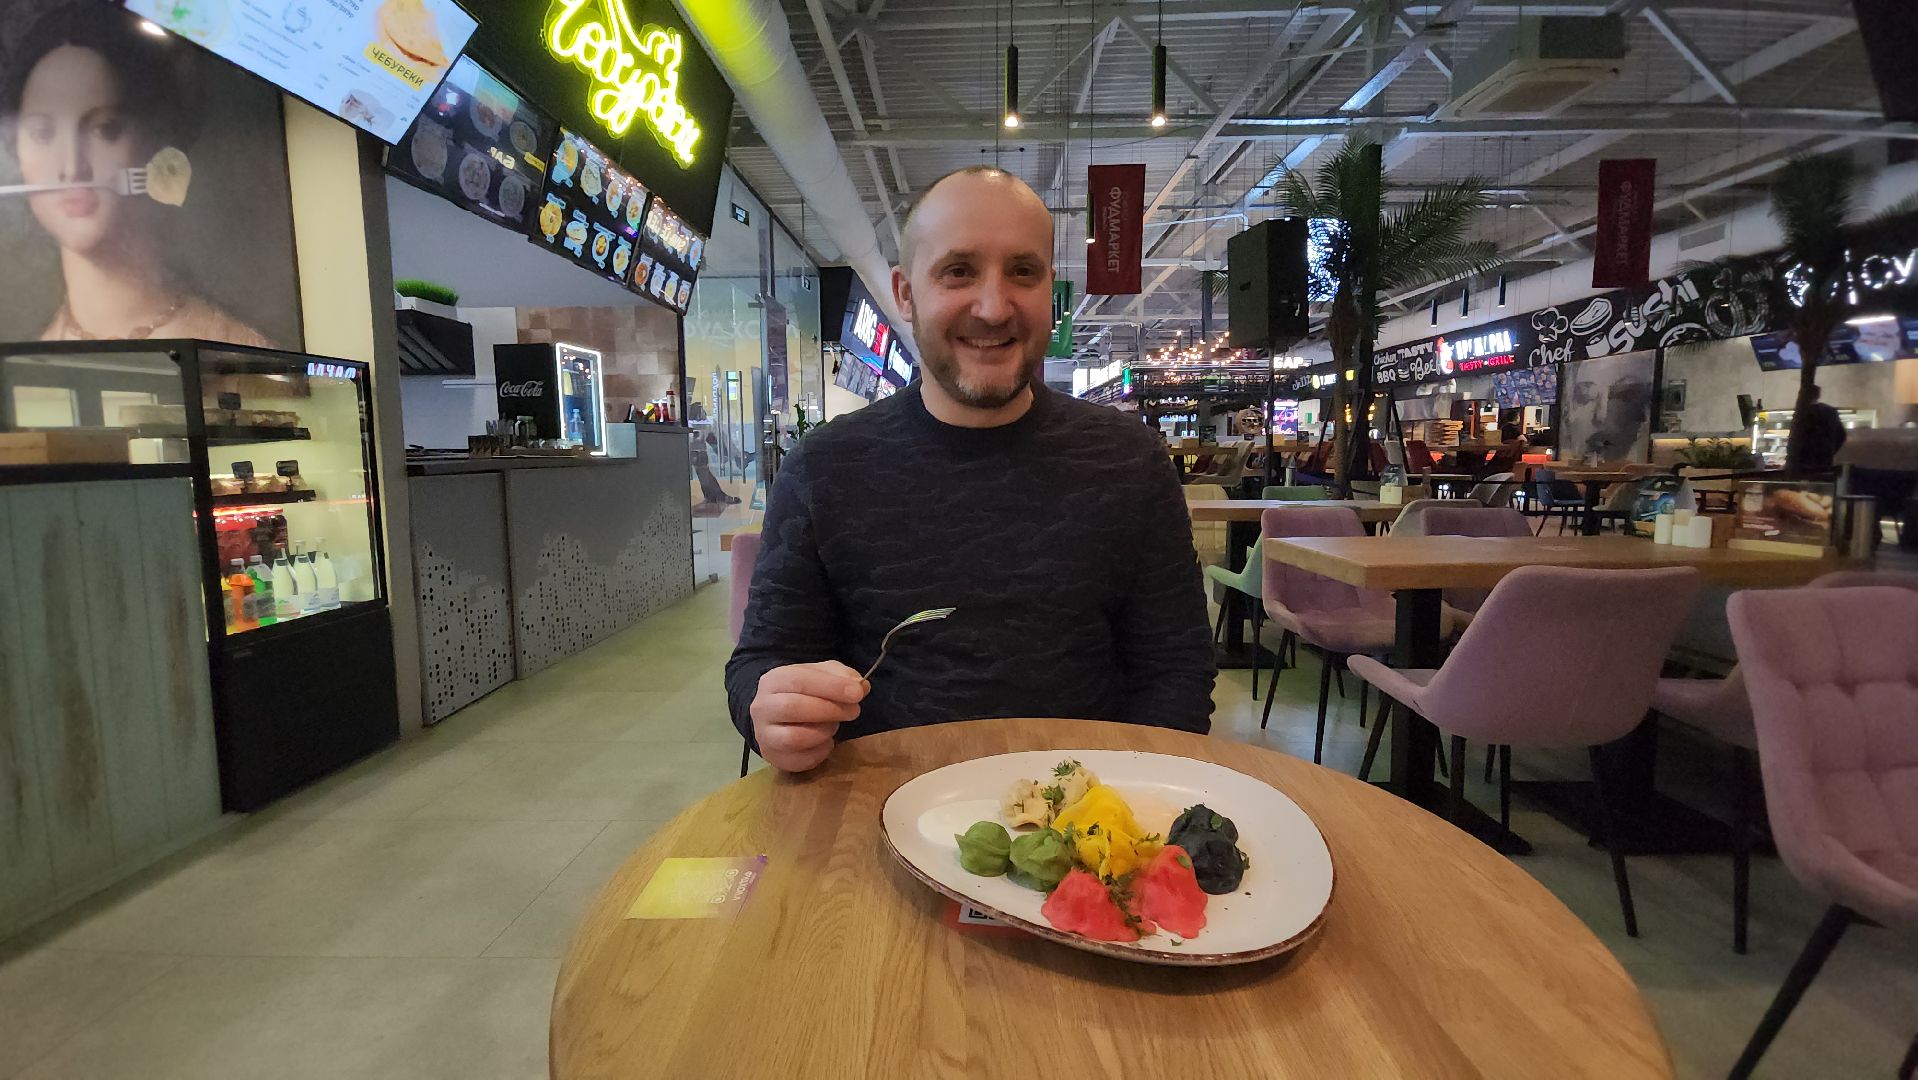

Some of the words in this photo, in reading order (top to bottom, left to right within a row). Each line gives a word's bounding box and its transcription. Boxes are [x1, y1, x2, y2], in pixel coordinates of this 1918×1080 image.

[372, 47, 424, 87] ЧЕБУРЕКИ
[1107, 186, 1122, 273] ФУДМАРКЕТ
[1397, 341, 1434, 358] TASTY
[1377, 368, 1396, 384] BBQ
